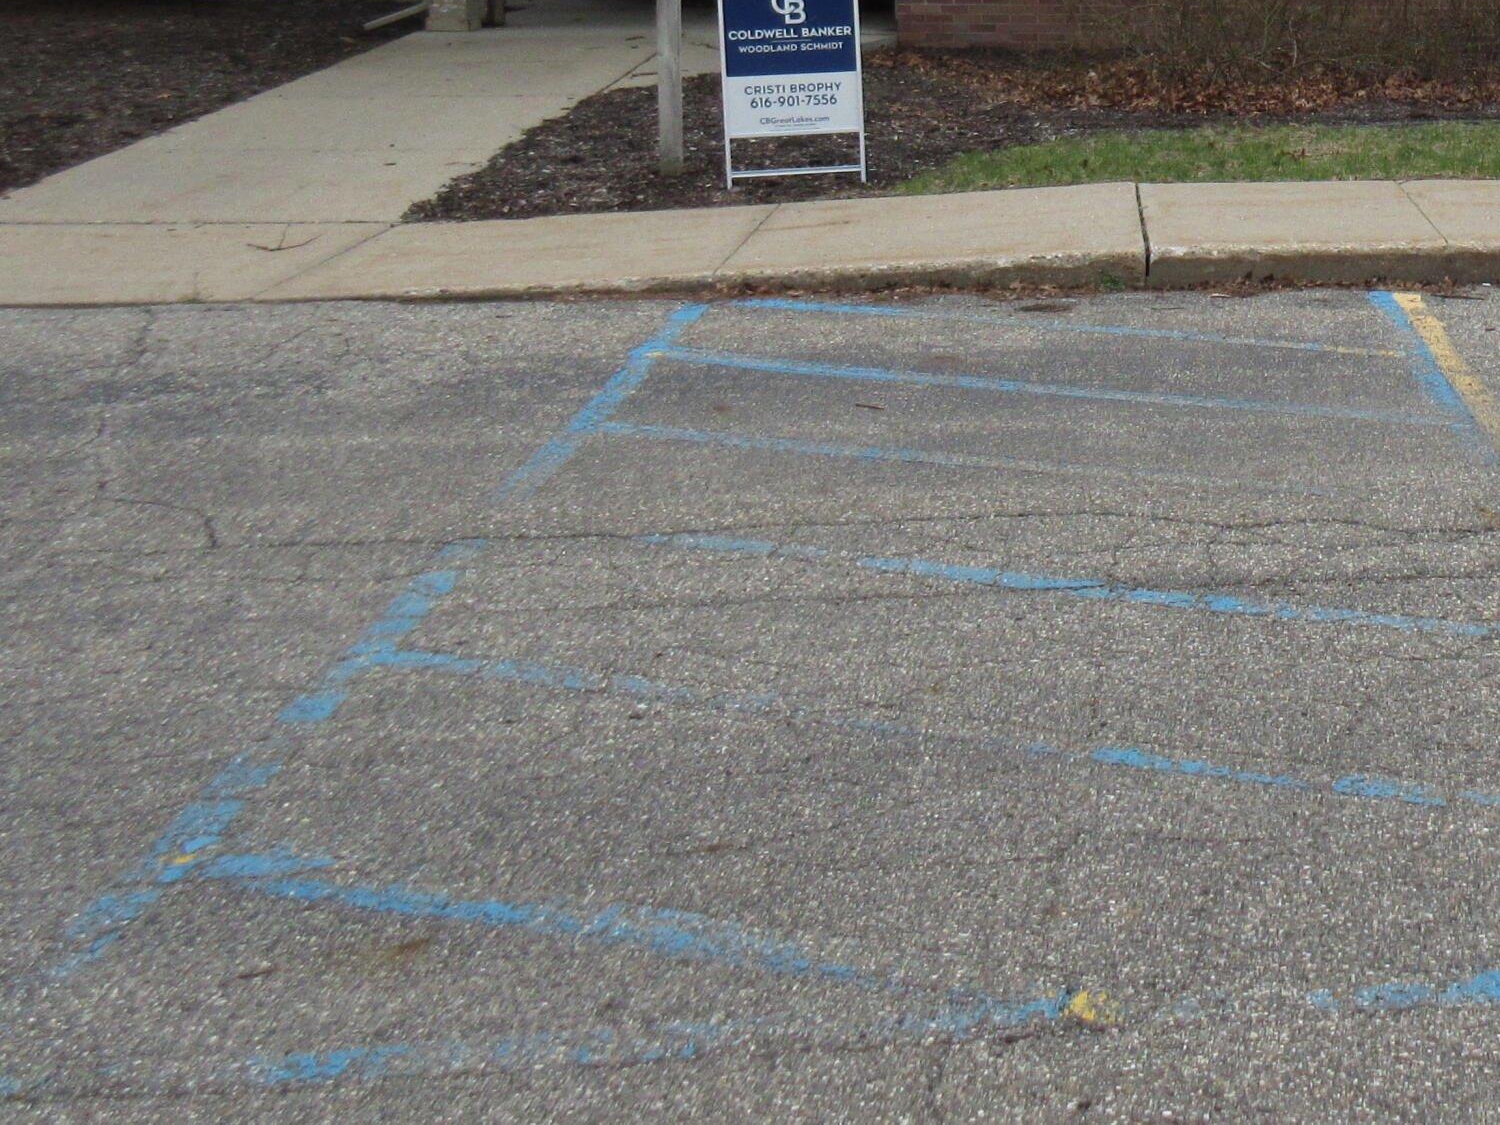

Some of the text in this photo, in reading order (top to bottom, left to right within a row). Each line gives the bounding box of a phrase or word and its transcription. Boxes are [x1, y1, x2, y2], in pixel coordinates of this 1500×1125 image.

[728, 26, 852, 40] COLDWELL BANKER
[738, 41, 844, 53] WOODLAND SCHMIDT
[744, 82, 842, 95] CRISTI BROPHY
[750, 94, 838, 109] 616-901-7556
[759, 116, 830, 124] CBGreatLakes.com
